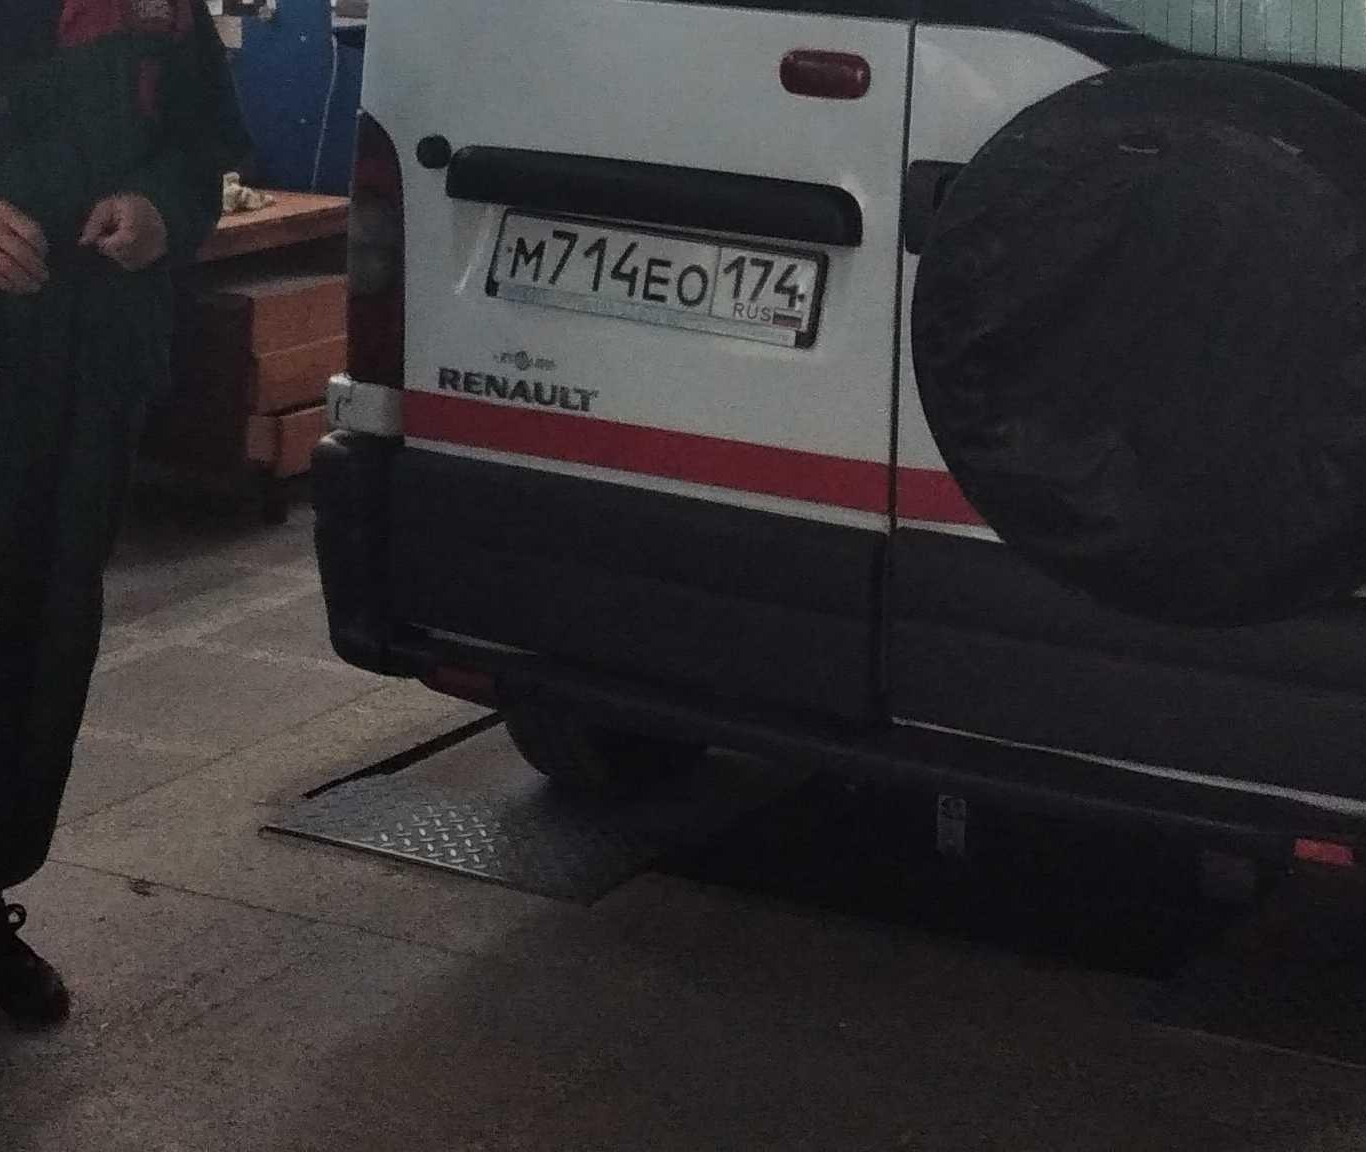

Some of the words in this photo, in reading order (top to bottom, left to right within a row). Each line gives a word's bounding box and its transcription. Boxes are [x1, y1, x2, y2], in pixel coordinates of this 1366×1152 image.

[723, 256, 801, 308] 174
[733, 302, 773, 322] RUS
[438, 367, 600, 412] RENAULT
